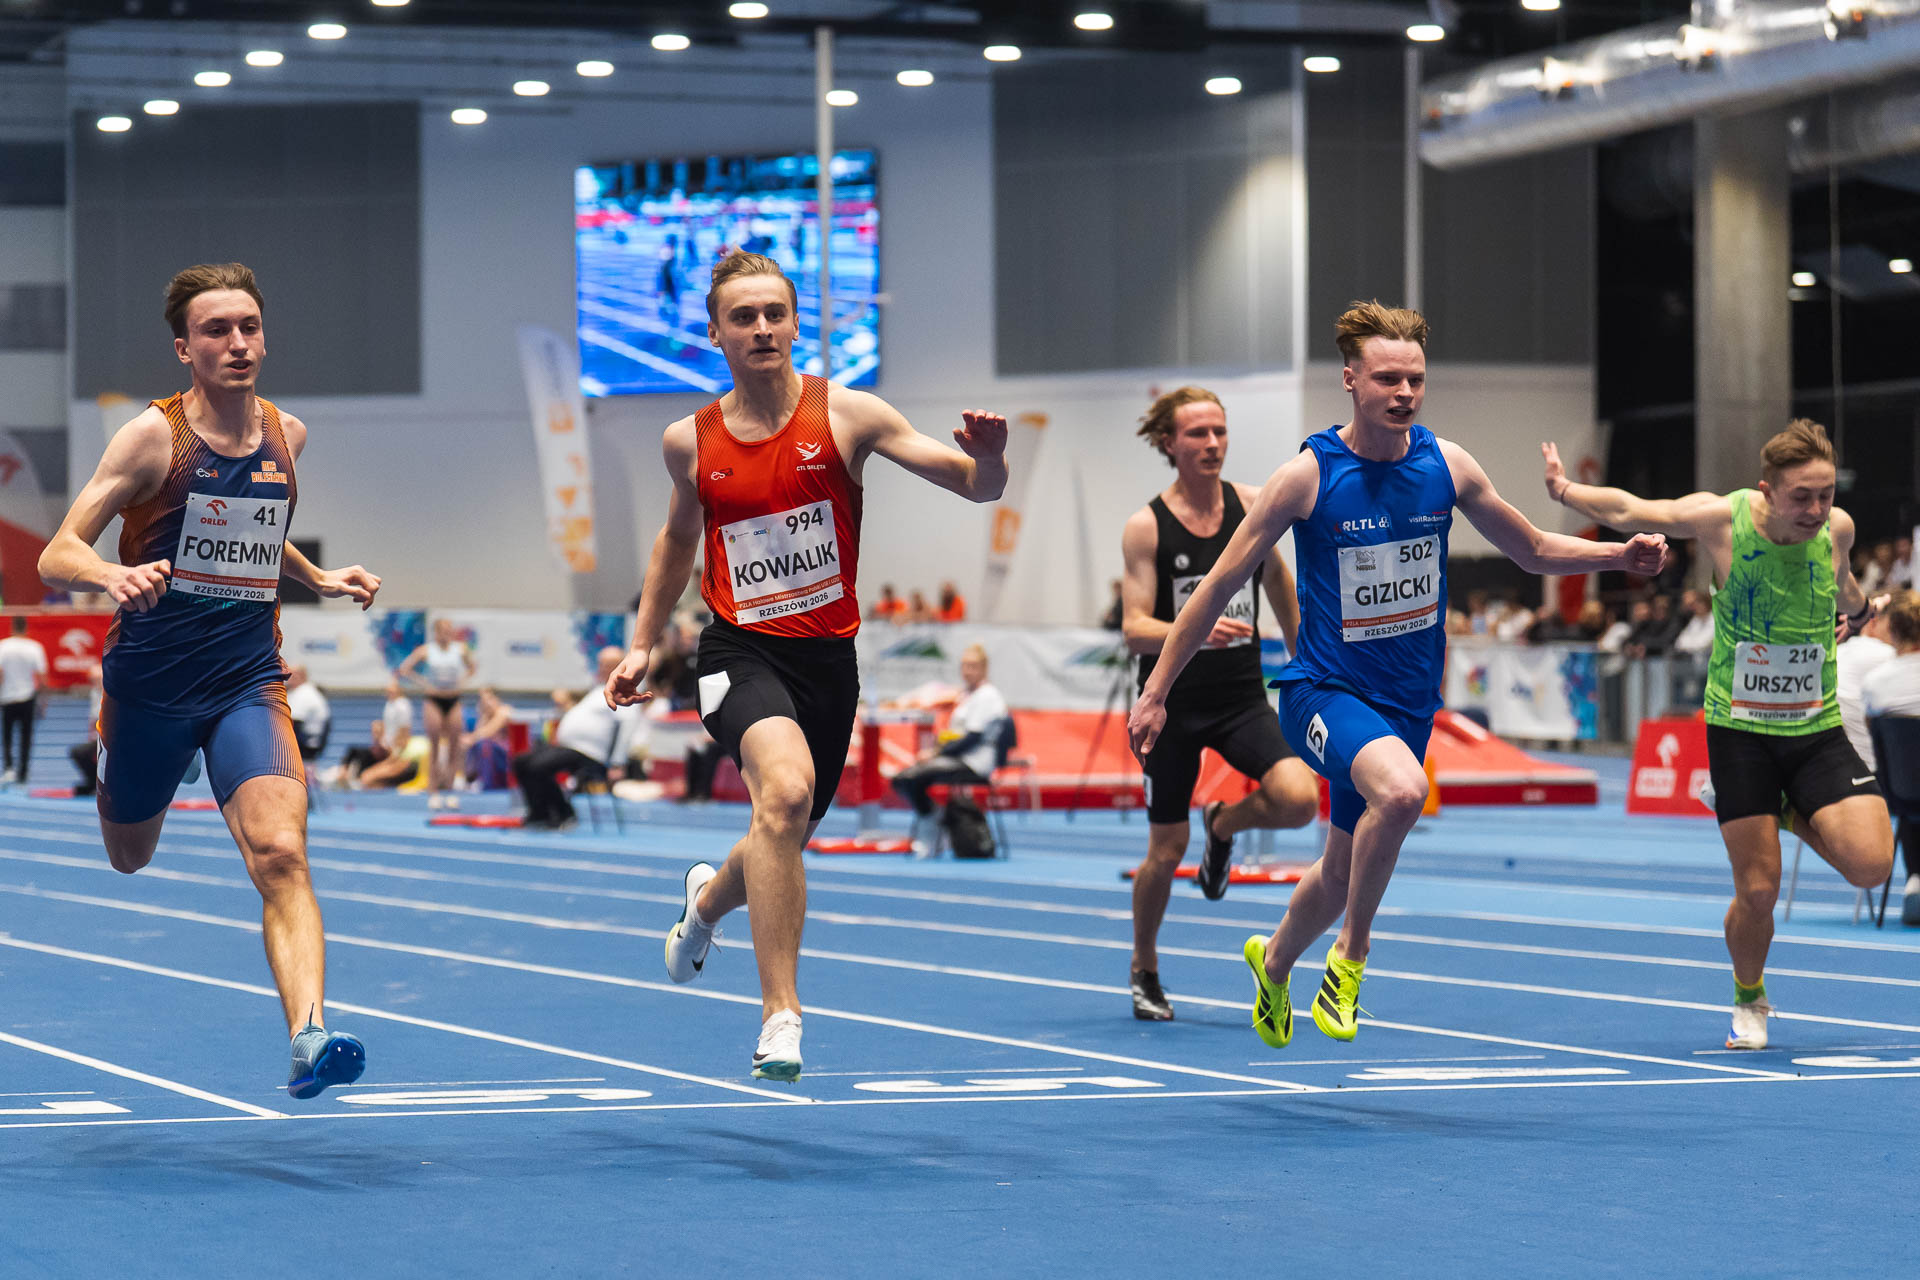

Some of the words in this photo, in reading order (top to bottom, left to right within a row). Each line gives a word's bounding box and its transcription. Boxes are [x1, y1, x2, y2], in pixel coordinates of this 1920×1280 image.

[200, 517, 227, 526] ORLEN
[253, 506, 276, 526] 41
[785, 507, 824, 535] 994
[1342, 518, 1376, 532] RLTL
[183, 535, 281, 565] FOREMNY
[1400, 540, 1433, 563] 502
[734, 541, 837, 587] KOWALIK
[194, 584, 242, 597] RZESZÓW
[244, 590, 265, 600] 2026
[1355, 574, 1431, 606] GIZICKI
[759, 600, 808, 617] RZESZÓW
[810, 592, 829, 605] 2026
[1364, 623, 1408, 637] RZESZÓW
[1788, 648, 1818, 664] 214
[1744, 673, 1814, 693] URSZYC
